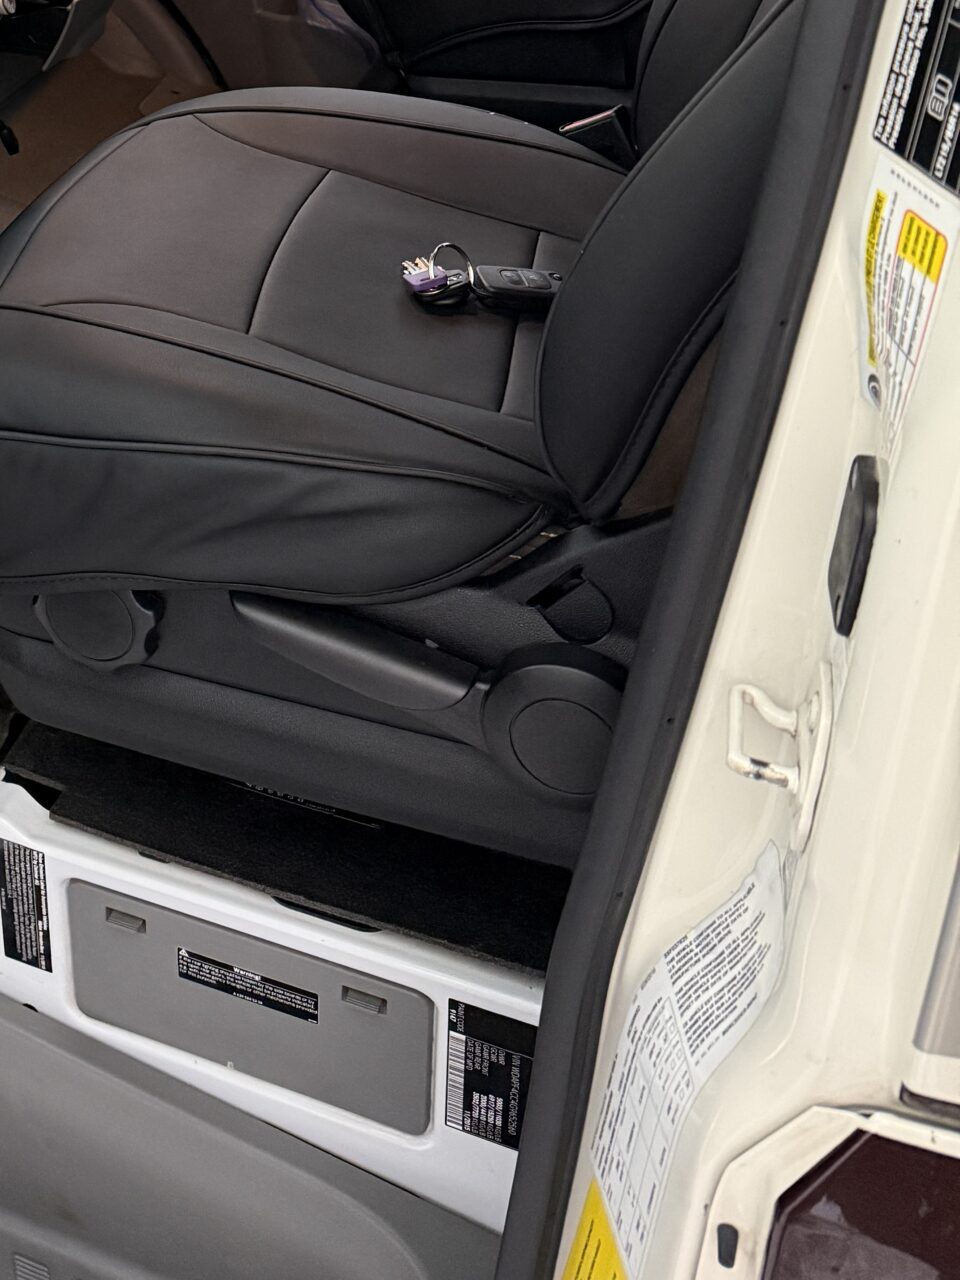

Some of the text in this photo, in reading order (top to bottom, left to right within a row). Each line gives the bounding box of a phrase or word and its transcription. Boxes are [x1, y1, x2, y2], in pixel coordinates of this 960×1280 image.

[891, 22, 910, 73] pressure
[879, 71, 896, 117] inflation
[881, 94, 899, 145] Pression
[893, 73, 905, 97] des
[899, 38, 915, 75] pneus
[874, 115, 885, 139] Tire
[675, 946, 693, 965] FEDERAL
[694, 932, 710, 949] MOTOR
[710, 917, 727, 934] VEHICLE
[675, 940, 692, 957] VEHICLE
[233, 966, 260, 981] Warning!
[683, 970, 699, 987] VEHICLE
[511, 1054, 520, 1067] VIN
